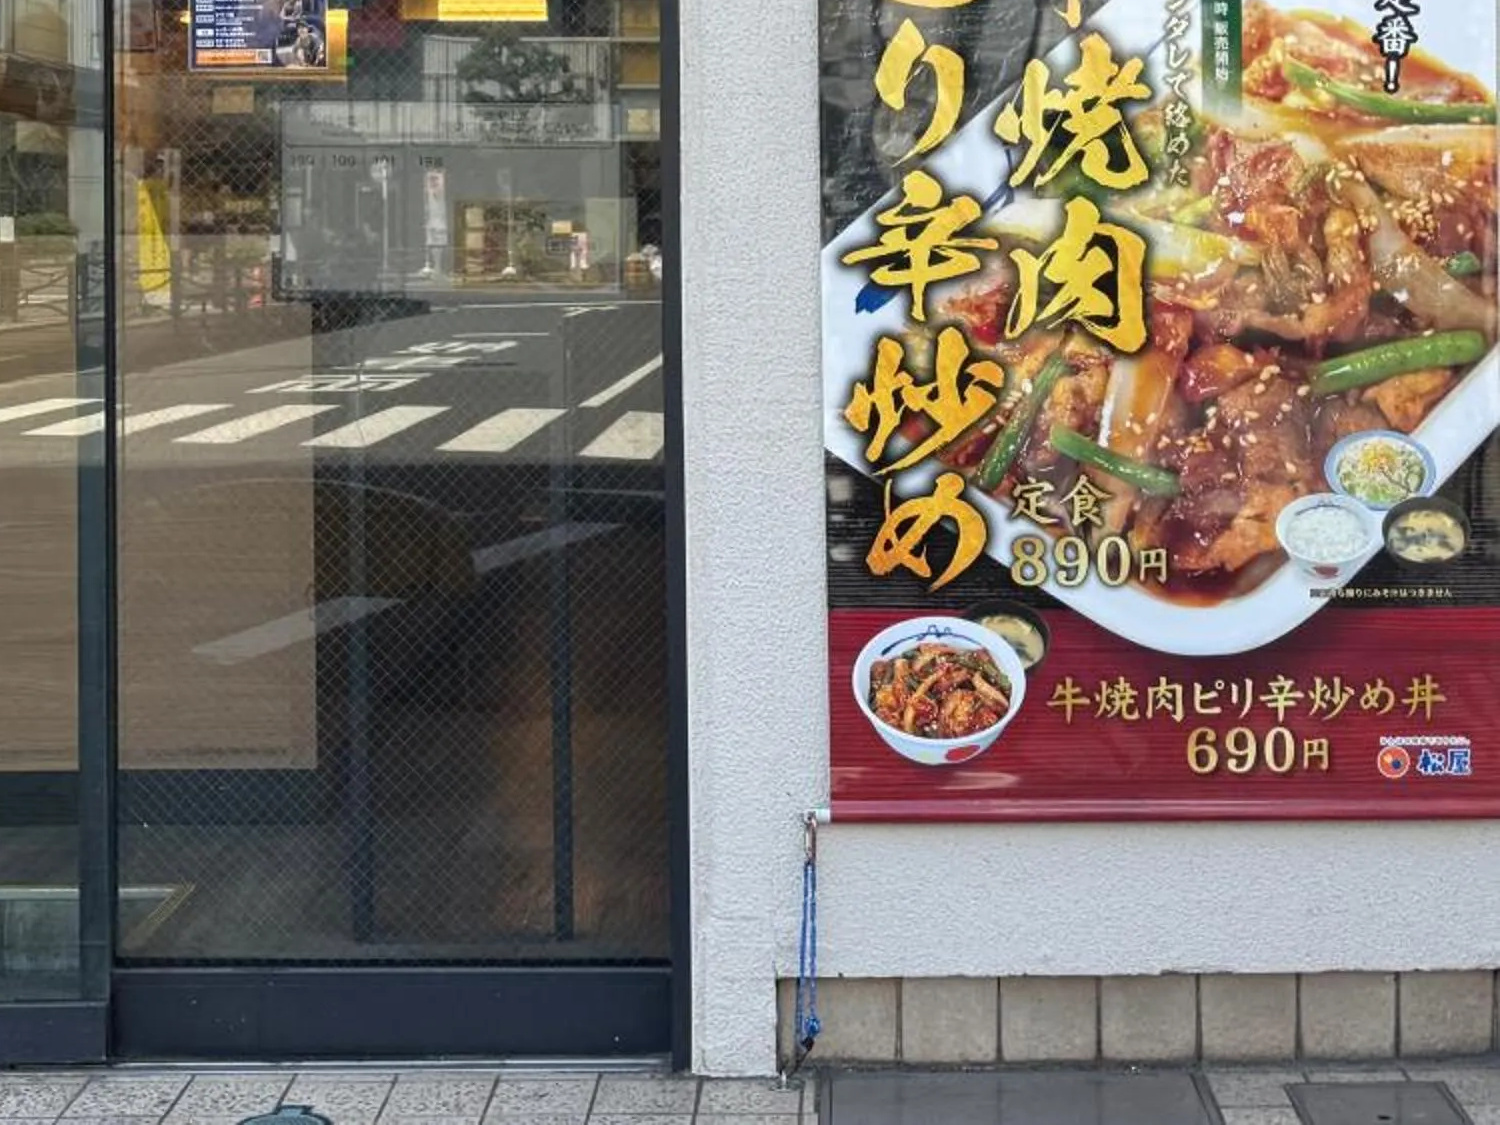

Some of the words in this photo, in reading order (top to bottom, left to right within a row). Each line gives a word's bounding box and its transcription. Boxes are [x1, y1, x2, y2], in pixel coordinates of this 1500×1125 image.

[1010, 476, 1113, 528] 定食
[1010, 535, 1168, 588] 890円
[1047, 675, 1447, 722] 牛焼肉ピリ辛炒め丼
[1185, 728, 1329, 774] 690円
[1416, 748, 1472, 775] 松屋
